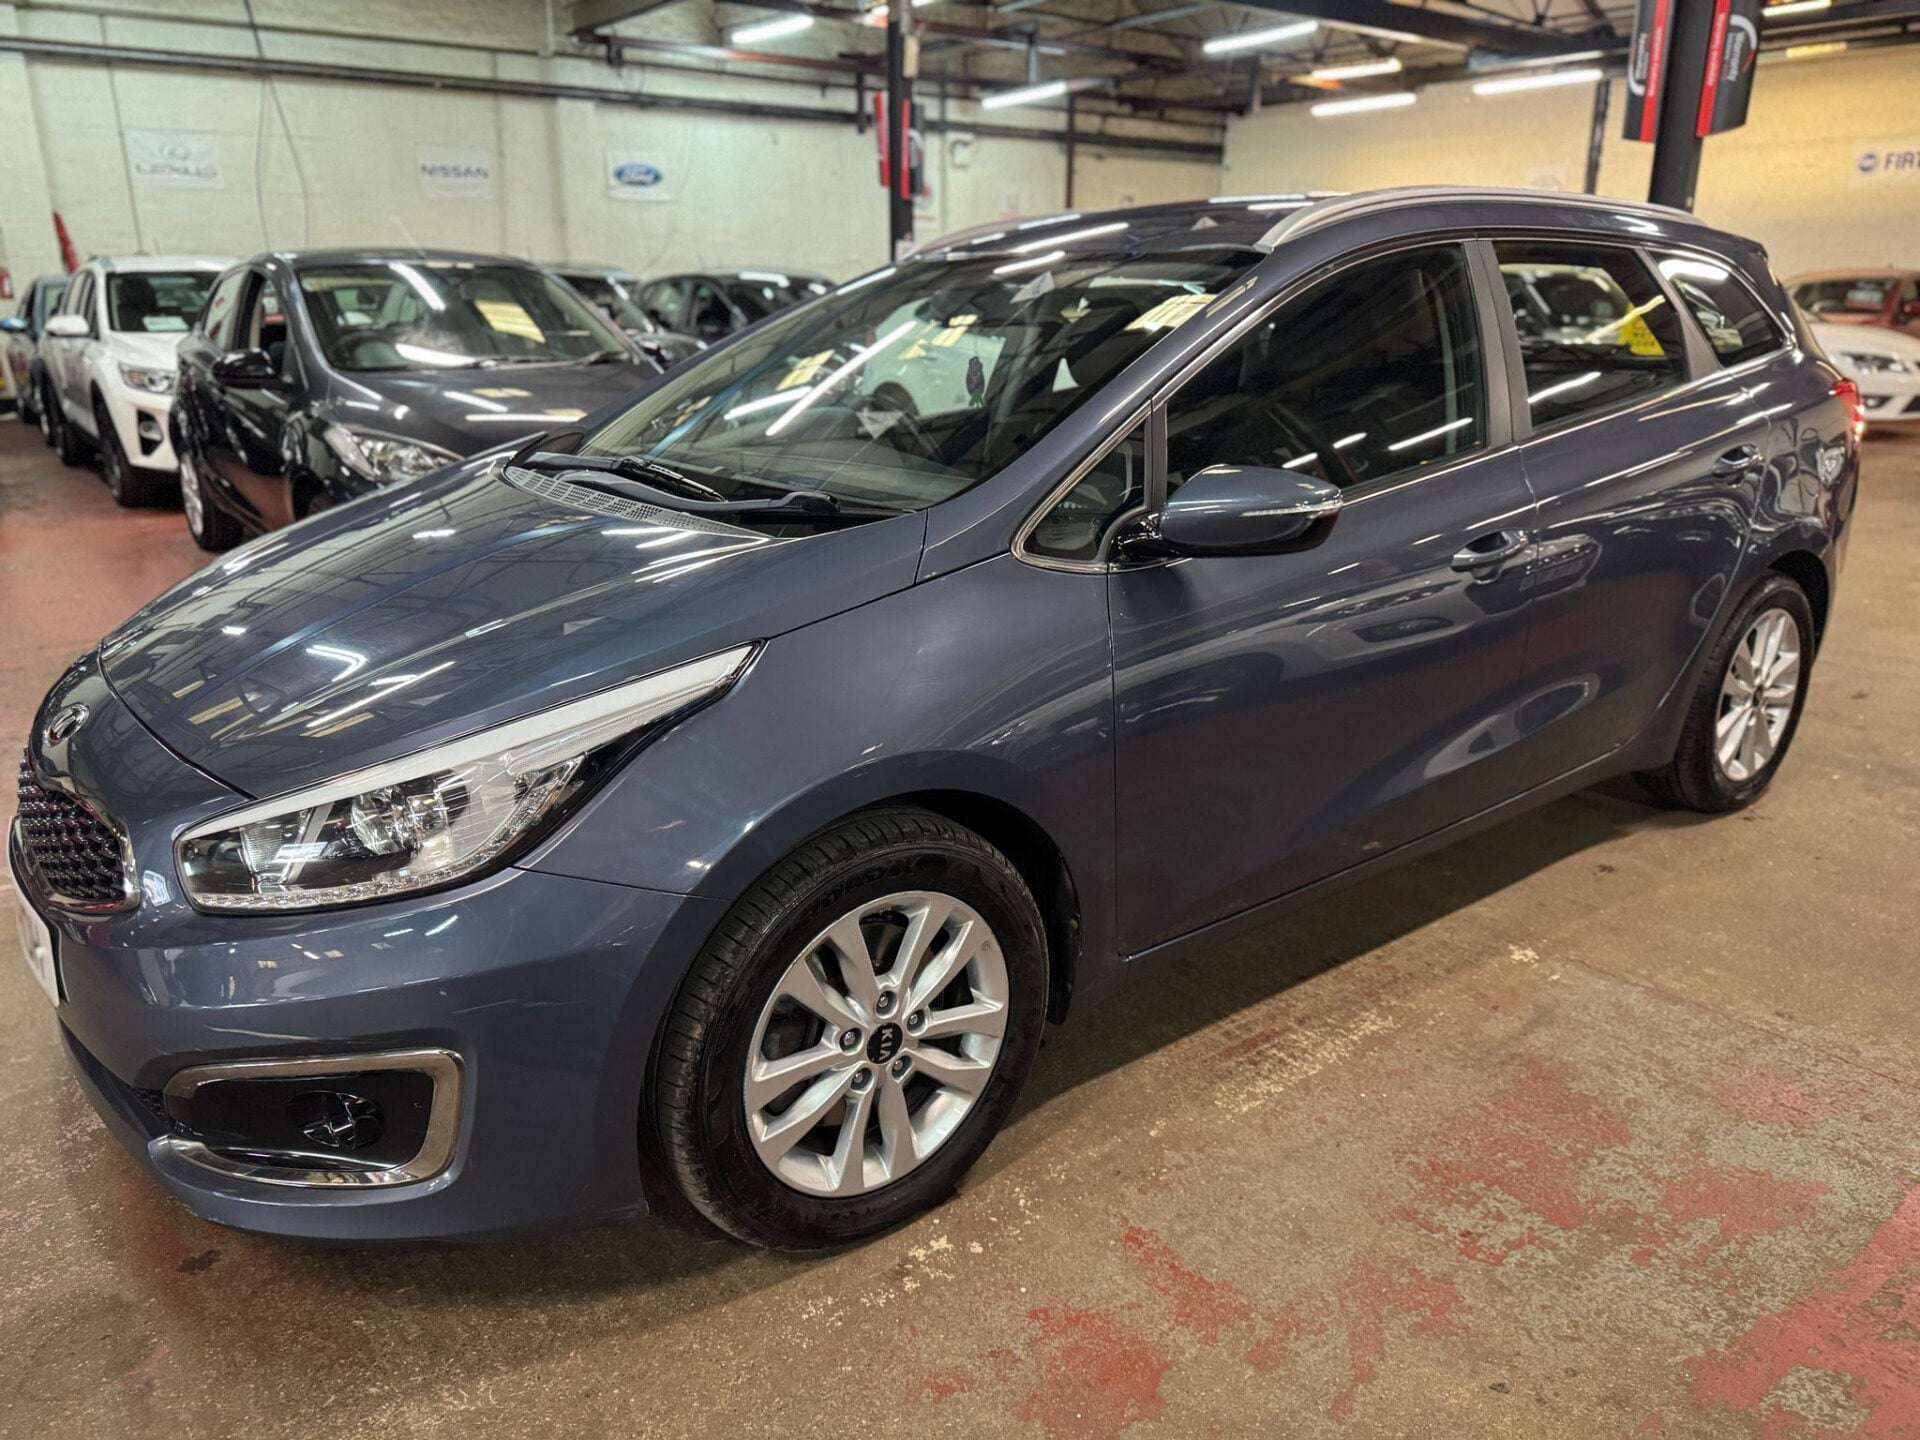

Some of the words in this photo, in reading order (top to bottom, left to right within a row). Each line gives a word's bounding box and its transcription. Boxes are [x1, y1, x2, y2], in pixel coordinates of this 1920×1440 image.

[420, 163, 488, 179] NISSAN
[618, 166, 659, 186] Ford
[879, 1027, 893, 1061] KIA
